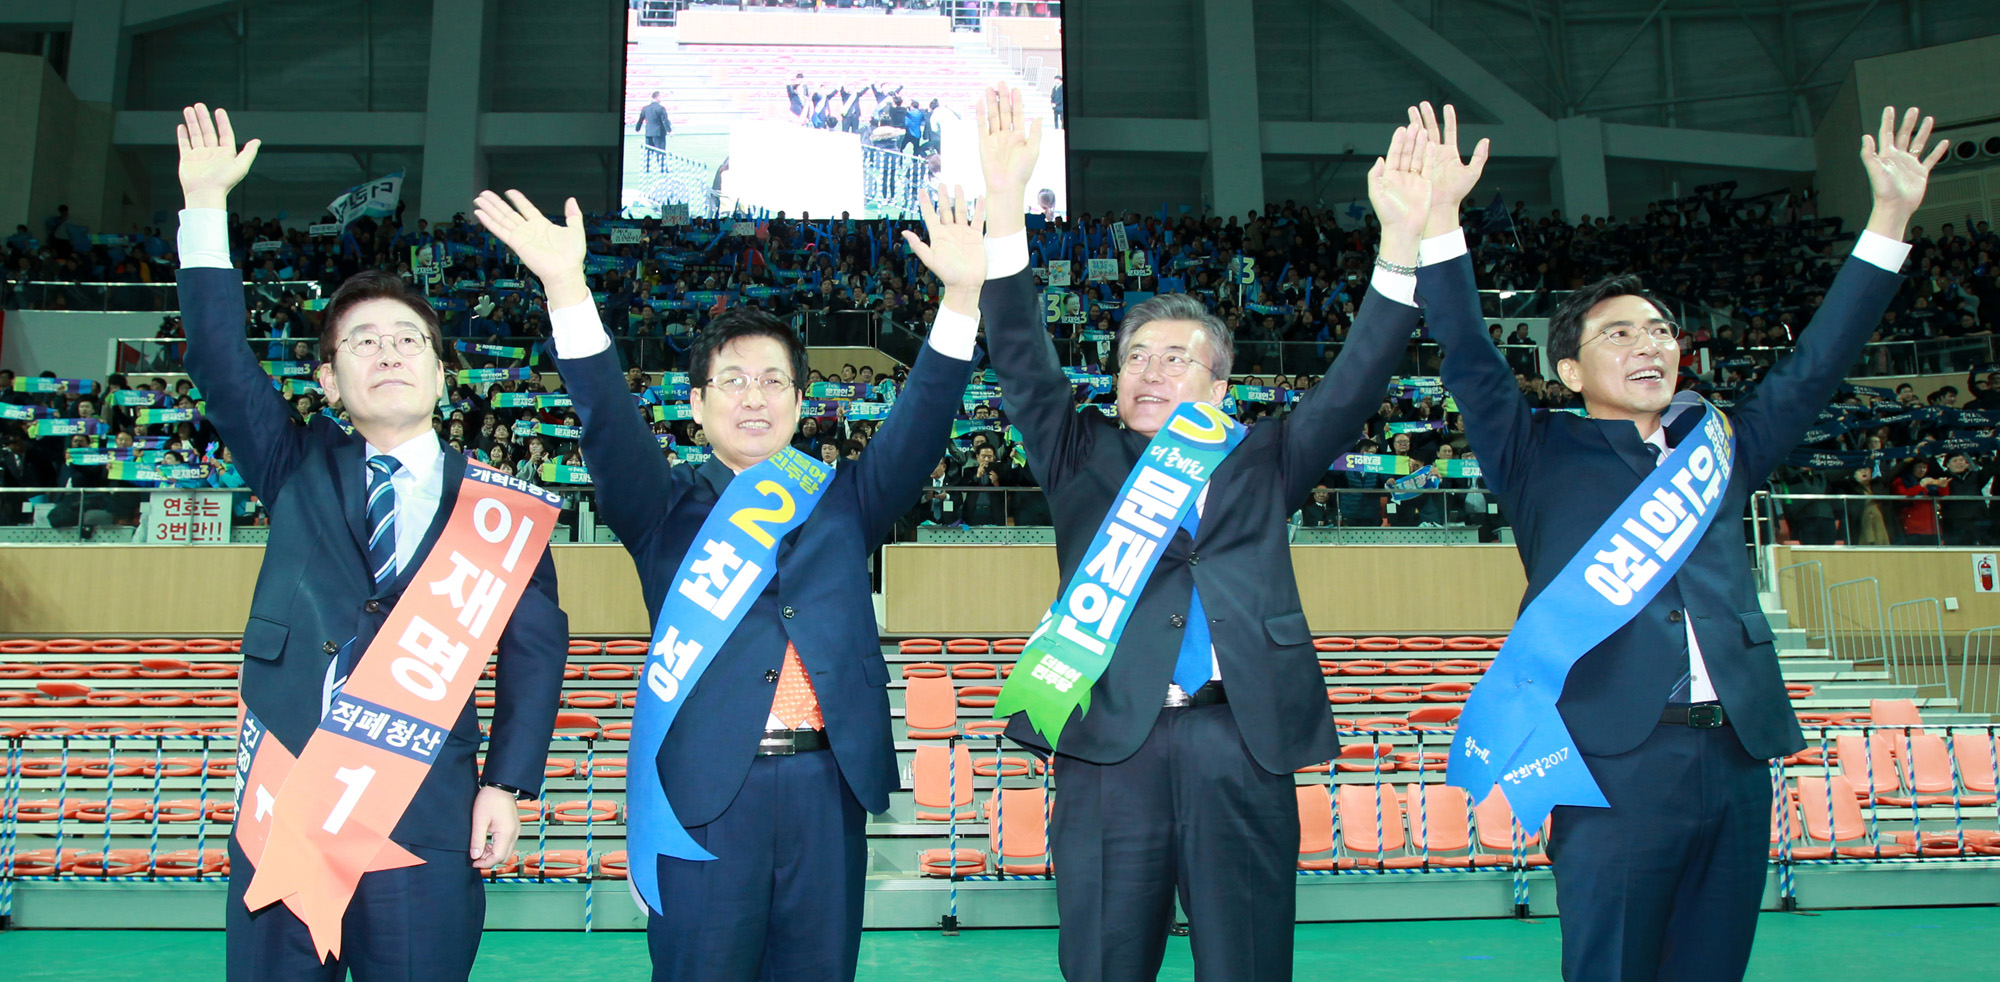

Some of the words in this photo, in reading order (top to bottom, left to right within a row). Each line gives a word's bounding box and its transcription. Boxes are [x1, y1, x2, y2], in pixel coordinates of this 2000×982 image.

[1241, 256, 1256, 284] 3
[1047, 294, 1061, 322] 3
[283, 363, 311, 375] 문재인3
[825, 385, 856, 397] 문재인3
[1248, 389, 1276, 401] 문재인3
[52, 421, 86, 435] 문재인3
[1166, 401, 1236, 445] 3
[170, 464, 209, 480] 문재인3
[769, 452, 821, 495] 민주당
[1149, 449, 1169, 463] 더
[1165, 456, 1206, 488] 준비된
[1345, 454, 1382, 469] 문재인3
[164, 498, 221, 517] 연호는
[728, 480, 796, 550] 2
[156, 522, 222, 541] 3번만!!
[1583, 444, 1721, 607] 안희정
[1056, 465, 1192, 657] 문재인
[389, 496, 535, 703] 이재명
[1030, 665, 1073, 695] 민주당
[1042, 653, 1083, 680] 더불어
[331, 698, 441, 759] 적폐청산
[321, 764, 377, 836] 1
